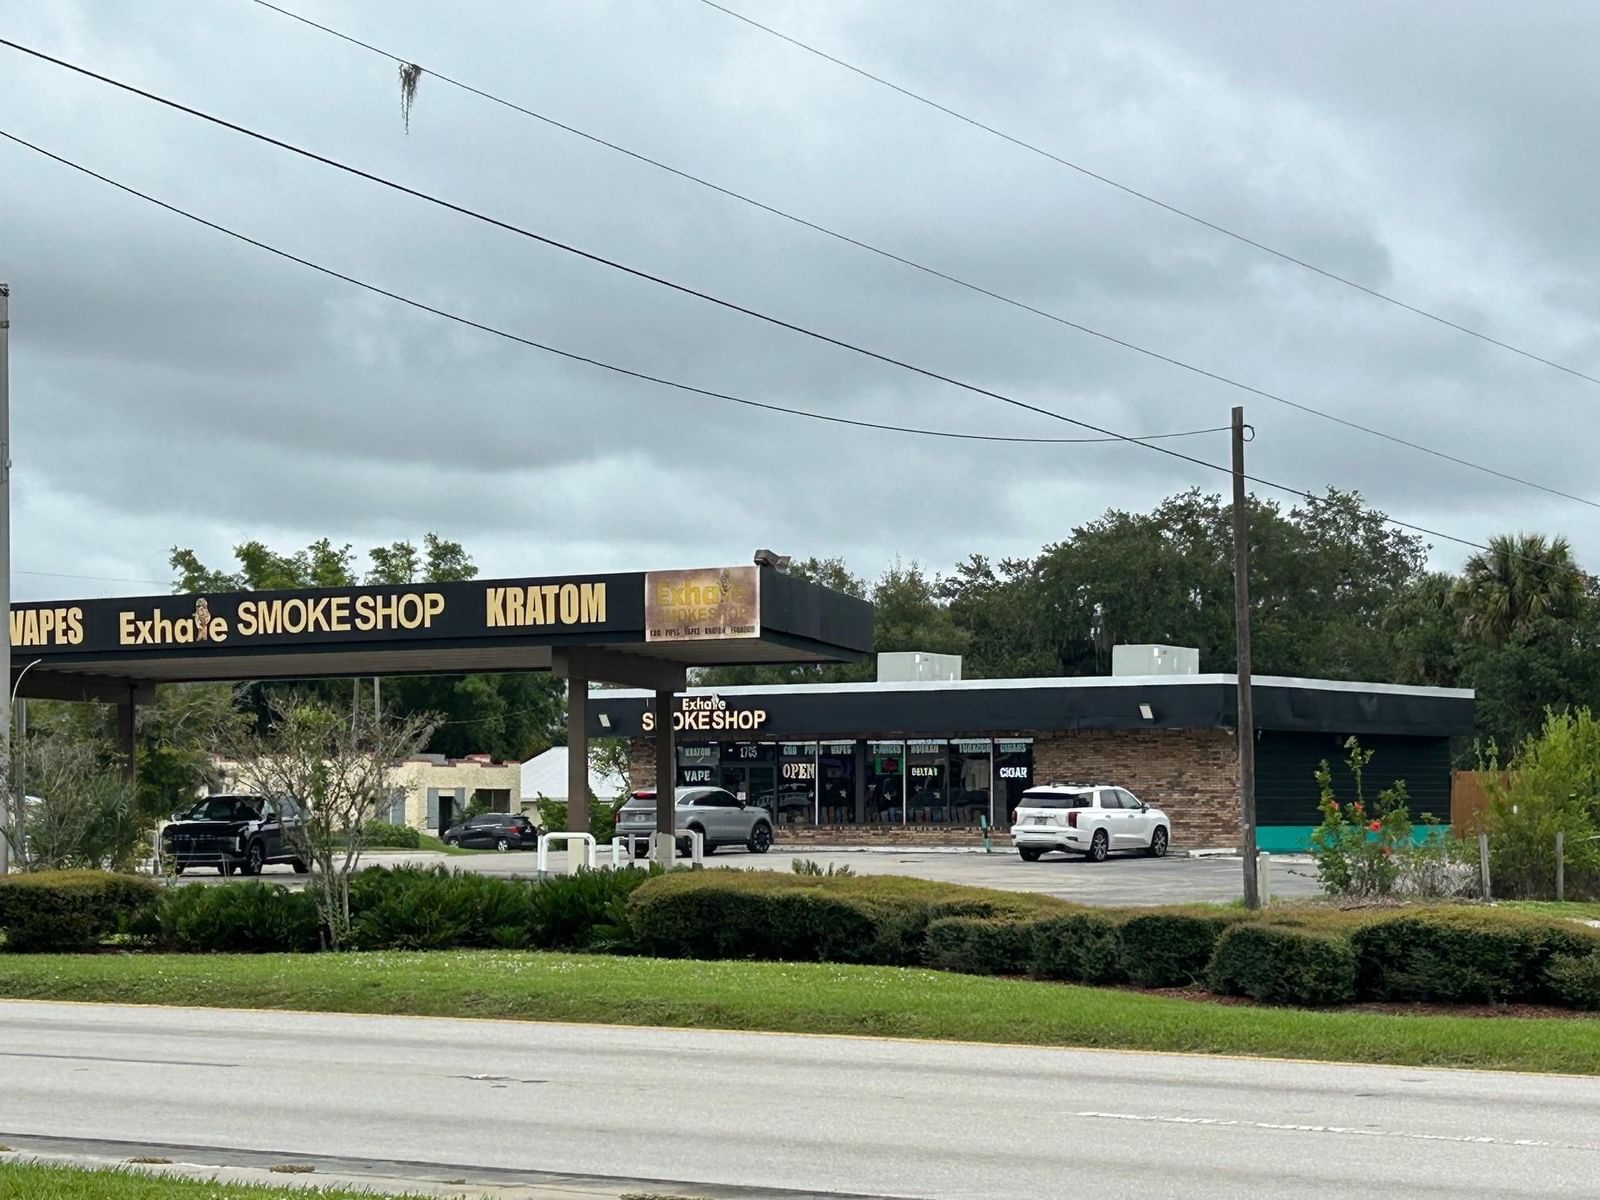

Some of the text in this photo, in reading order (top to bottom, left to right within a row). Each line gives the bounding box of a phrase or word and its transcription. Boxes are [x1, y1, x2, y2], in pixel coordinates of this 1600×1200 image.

[486, 583, 606, 627] KRATOM
[9, 606, 84, 647] VAPES
[684, 770, 711, 782] VAPE
[782, 763, 815, 779] OPEN
[999, 766, 1028, 778] CIGAR
